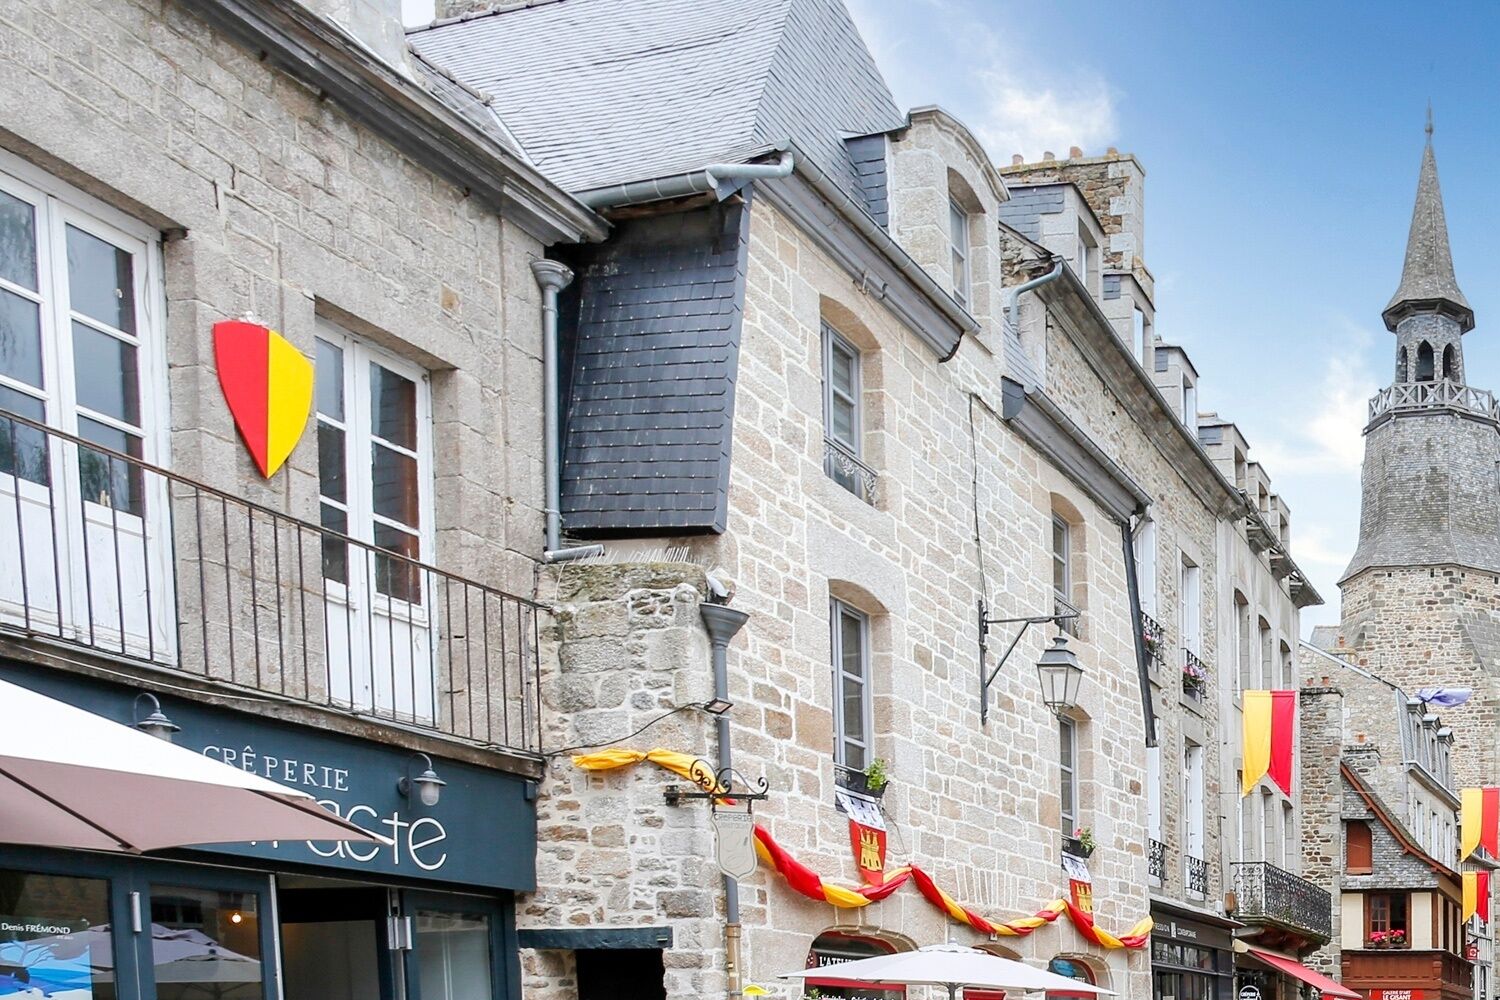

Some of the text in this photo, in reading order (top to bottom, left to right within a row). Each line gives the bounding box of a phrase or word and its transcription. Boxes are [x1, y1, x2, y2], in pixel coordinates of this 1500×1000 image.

[203, 745, 349, 792] CRÊPERIE
[1, 922, 71, 934] Denis FRÉMOND
